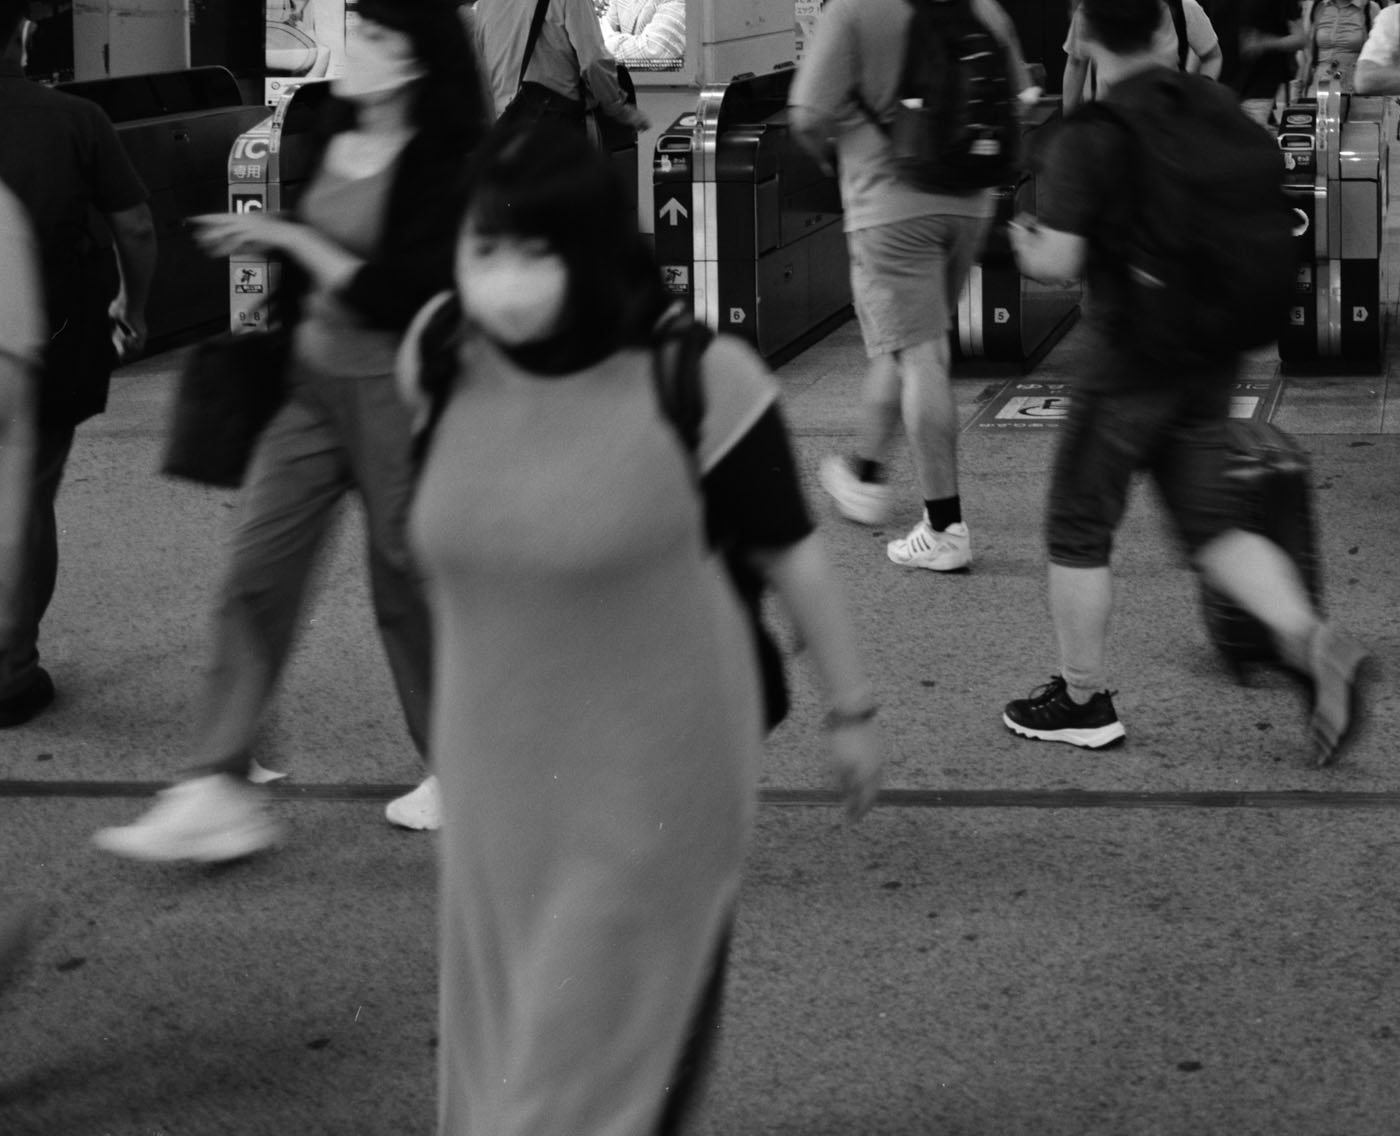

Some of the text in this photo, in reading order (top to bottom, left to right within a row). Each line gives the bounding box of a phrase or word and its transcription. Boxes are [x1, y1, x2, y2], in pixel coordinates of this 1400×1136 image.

[235, 138, 270, 160] IC
[233, 165, 261, 179] 専用
[733, 310, 740, 320] 6
